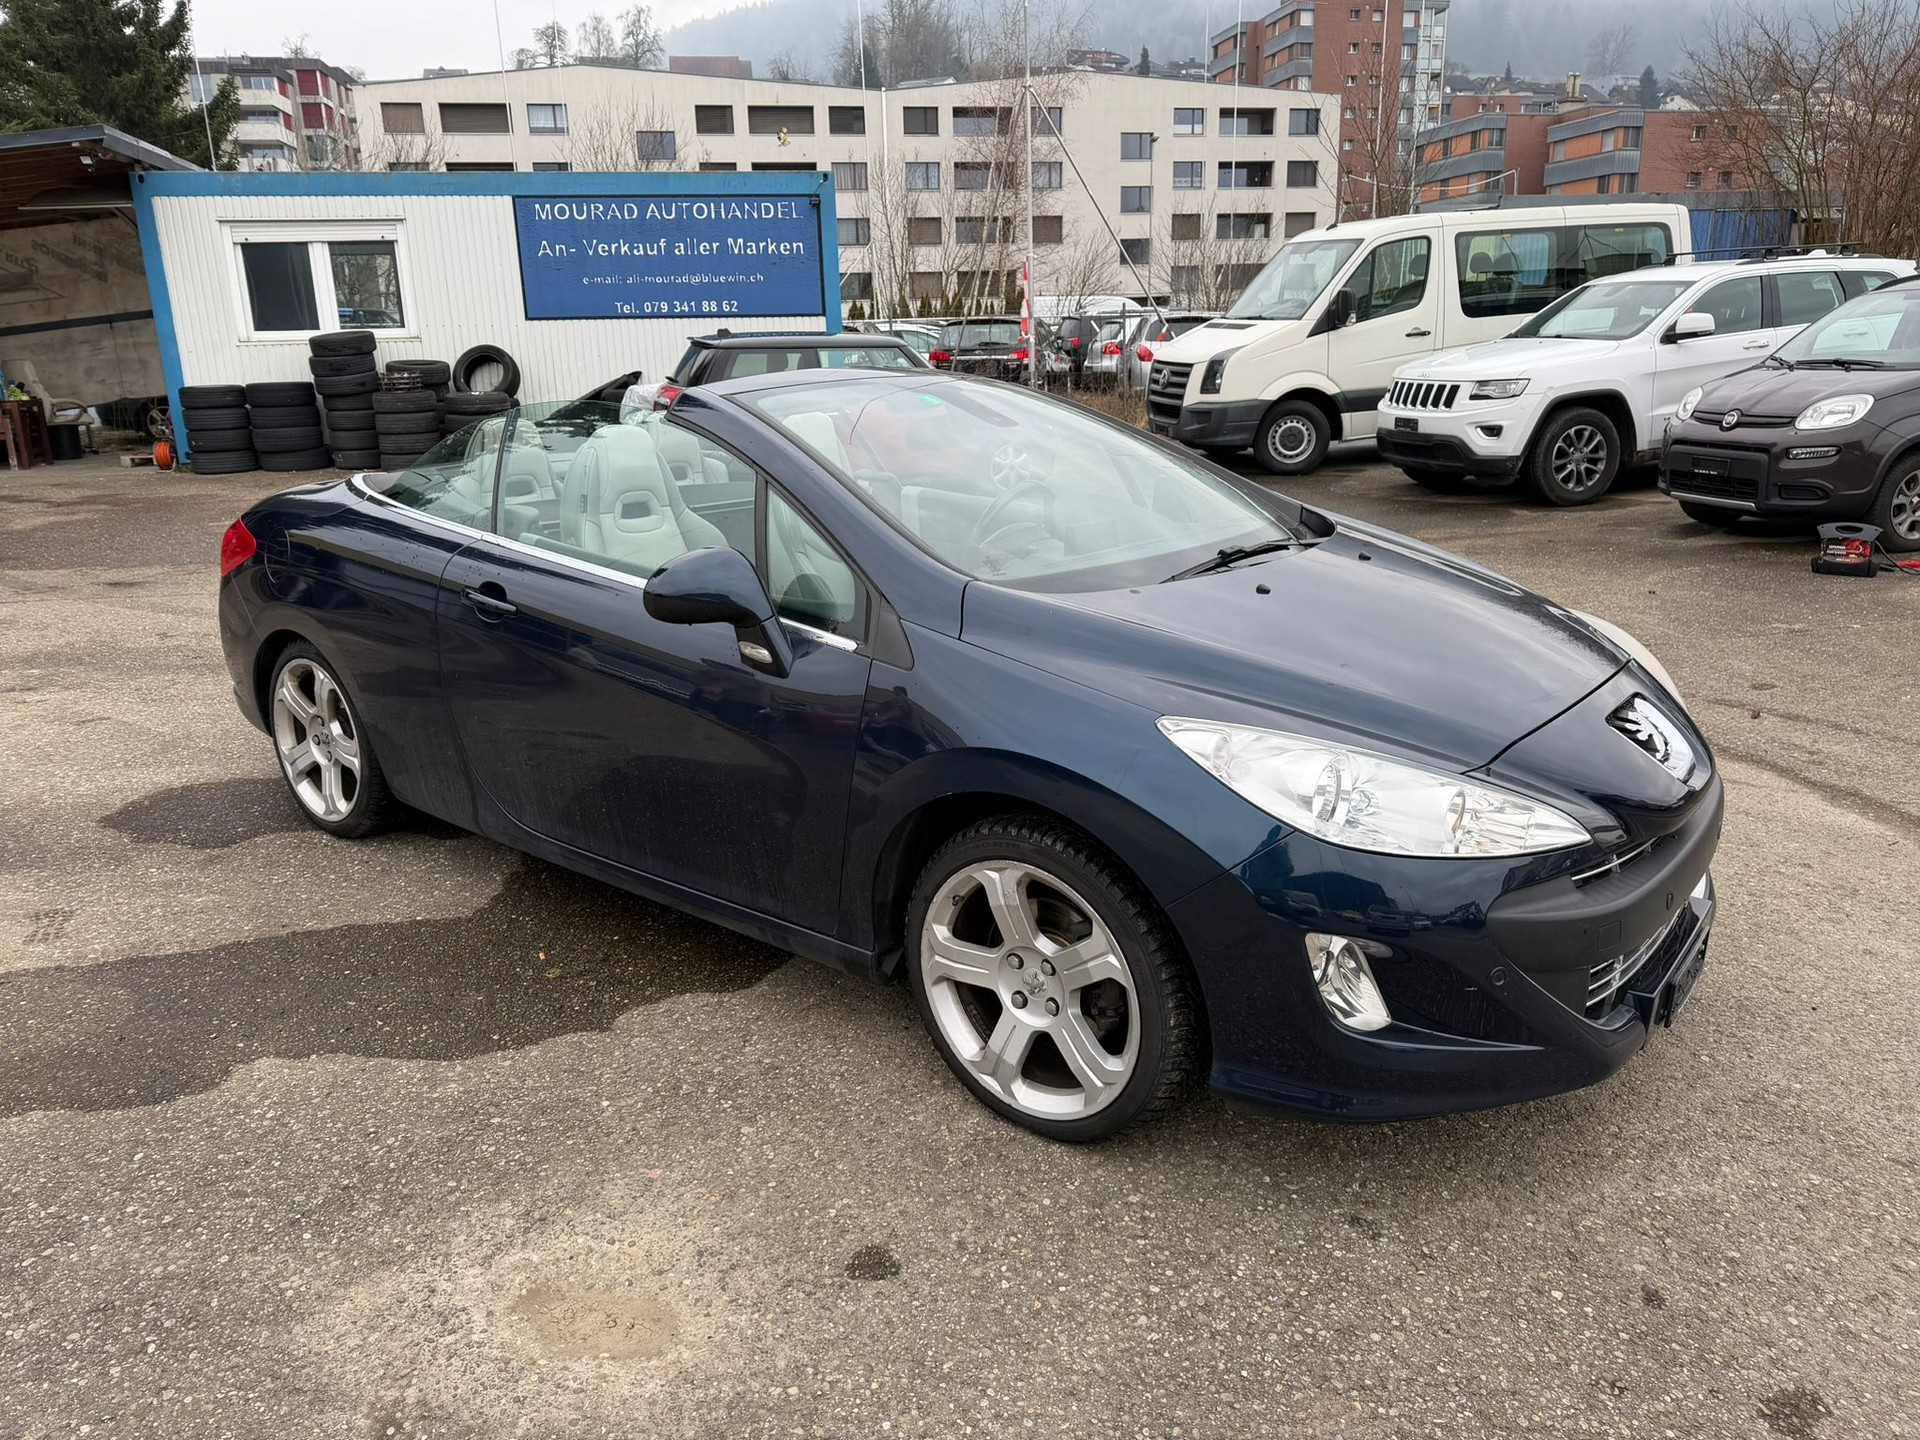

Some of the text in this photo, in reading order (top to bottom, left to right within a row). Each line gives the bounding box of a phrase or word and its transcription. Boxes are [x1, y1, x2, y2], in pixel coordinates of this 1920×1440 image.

[534, 201, 804, 221] MOURAD AUTOHANDEL
[537, 237, 805, 257] An- Verkauf aller Marken
[582, 272, 764, 286] e-mail: ali-mourad@bluewin.ch
[615, 300, 739, 314] Tel. 079 341 88 62
